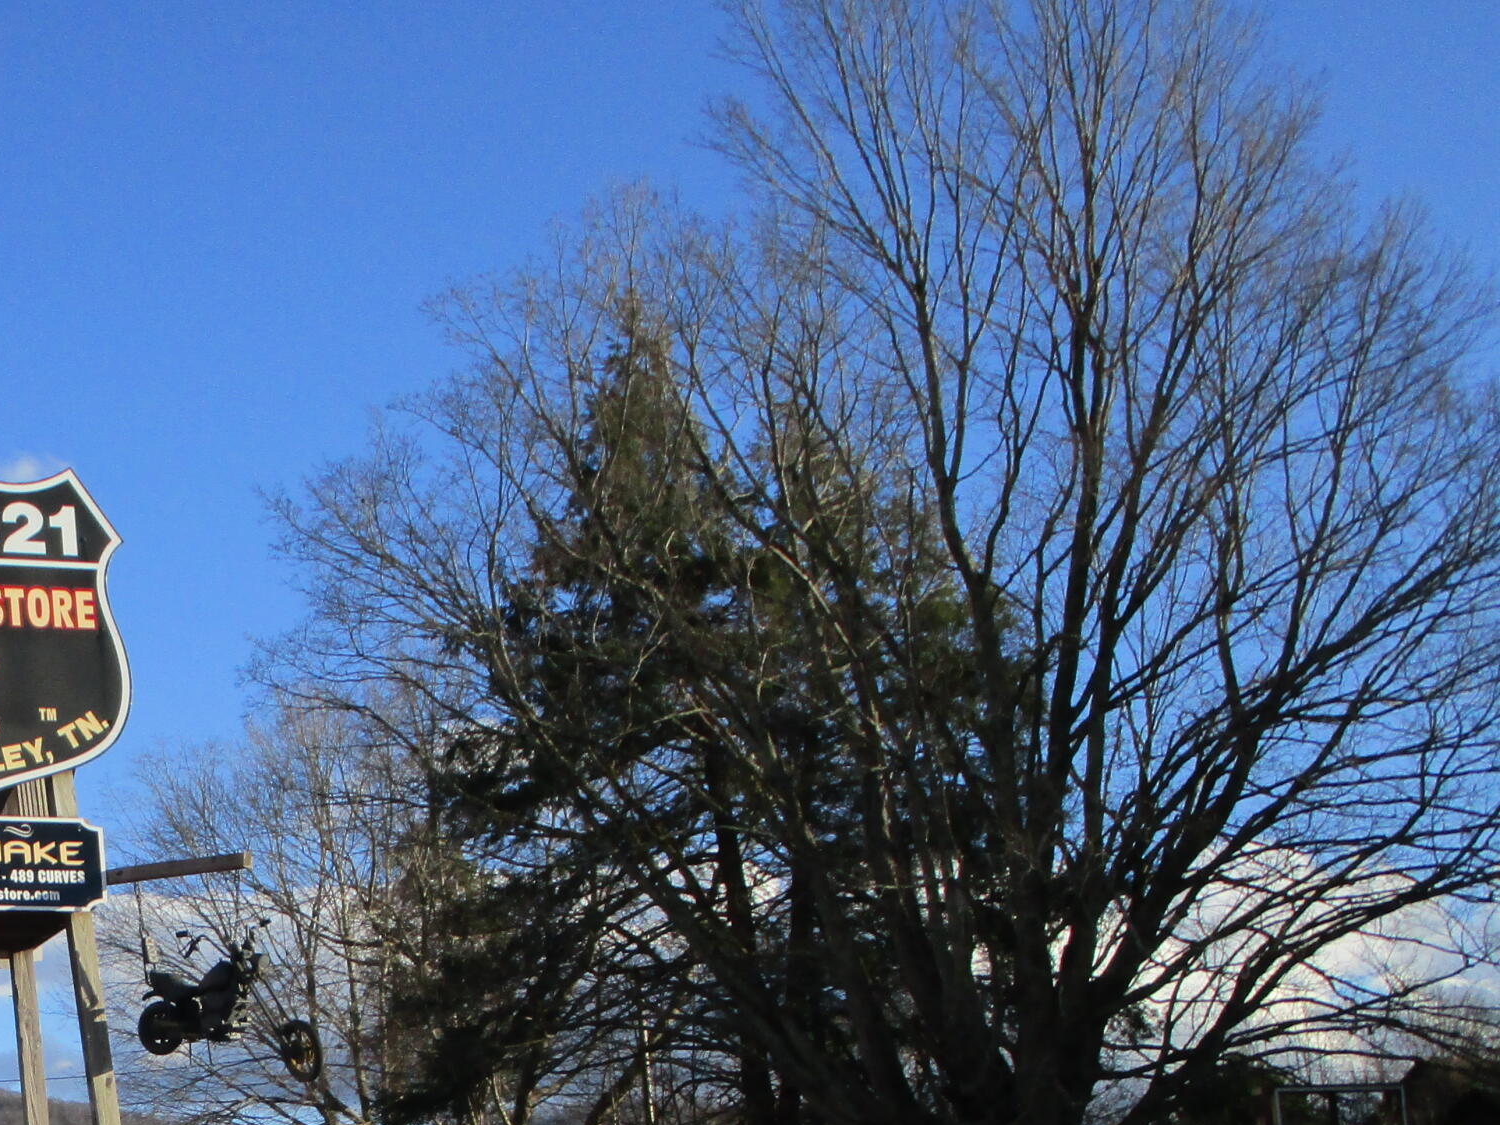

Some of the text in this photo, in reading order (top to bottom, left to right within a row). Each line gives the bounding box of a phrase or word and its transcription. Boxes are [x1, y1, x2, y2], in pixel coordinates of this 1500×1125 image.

[38, 706, 57, 721] TM
[56, 709, 111, 751] TN.
[10, 869, 35, 884] 489
[38, 869, 86, 884] CURVES
